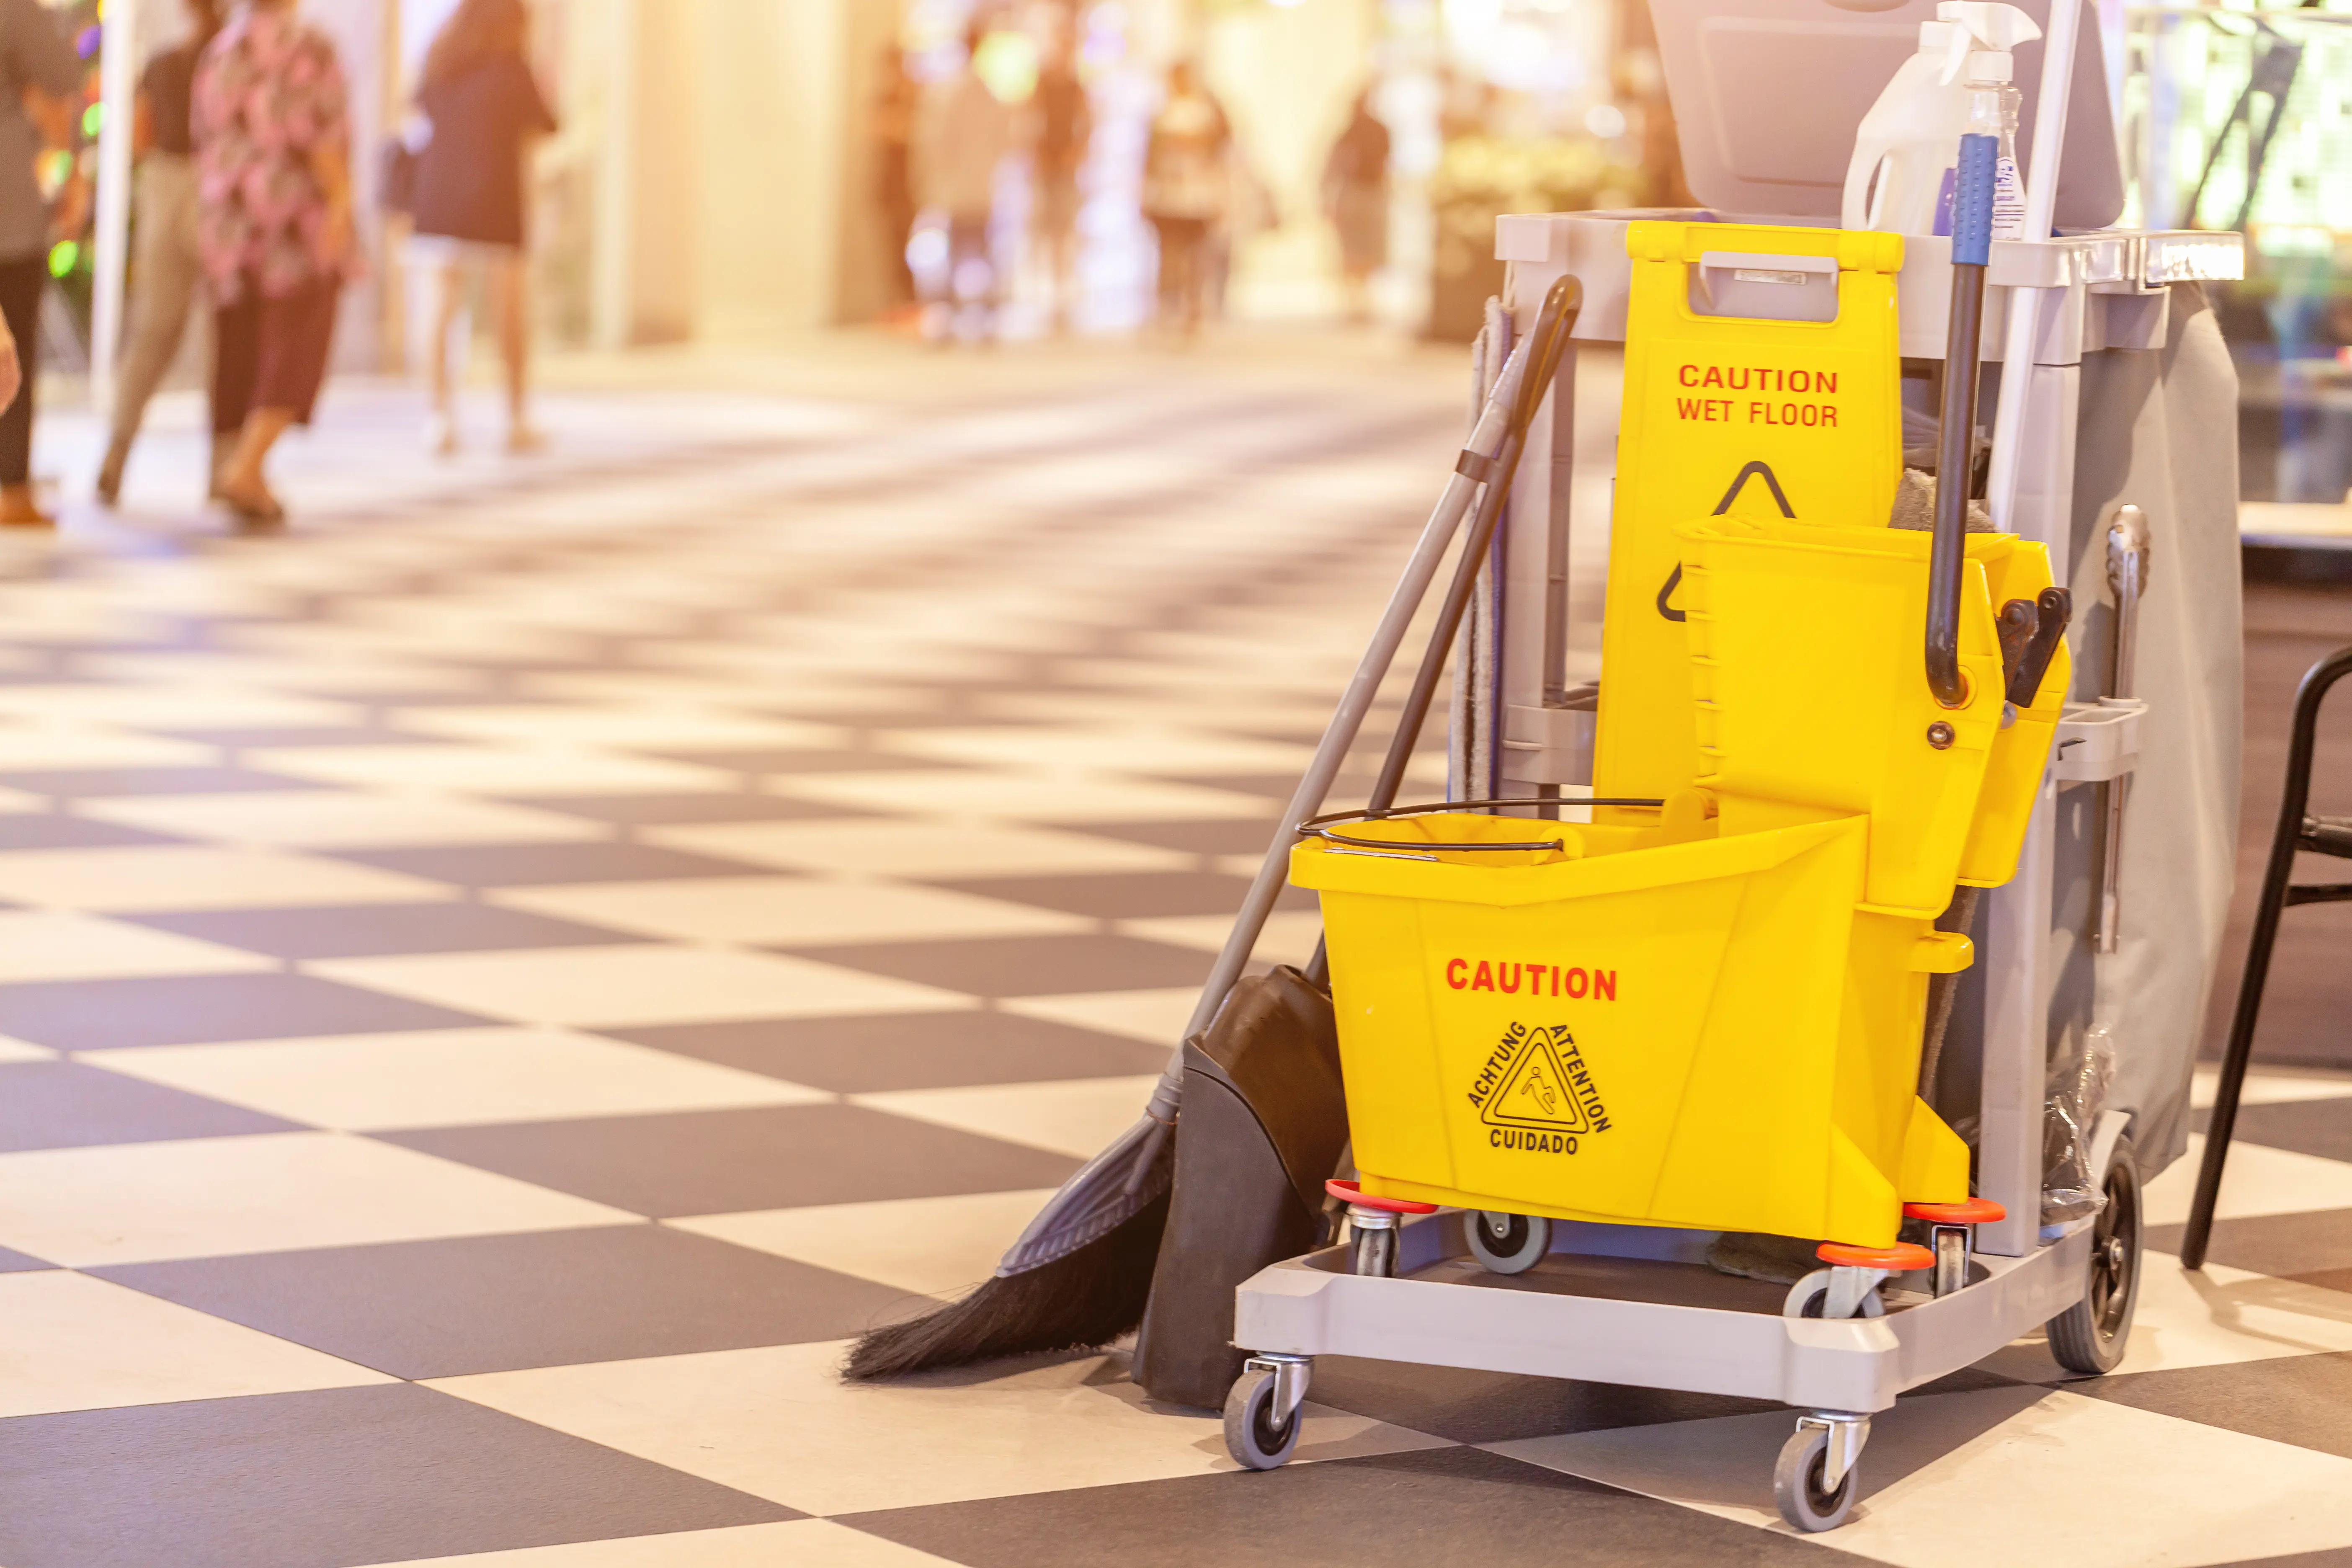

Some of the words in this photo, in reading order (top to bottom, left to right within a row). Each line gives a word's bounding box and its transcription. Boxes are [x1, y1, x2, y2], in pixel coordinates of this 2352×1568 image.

[1679, 364, 1838, 394] CAUTION
[1676, 397, 1734, 422] WET
[1749, 402, 1838, 427] FLOOR
[1446, 958, 1617, 1001] CAUTION
[1467, 1021, 1527, 1109] ACHTUNG
[1549, 1024, 1613, 1134] ATTENTION
[1489, 1129, 1578, 1155] CUIDADO
